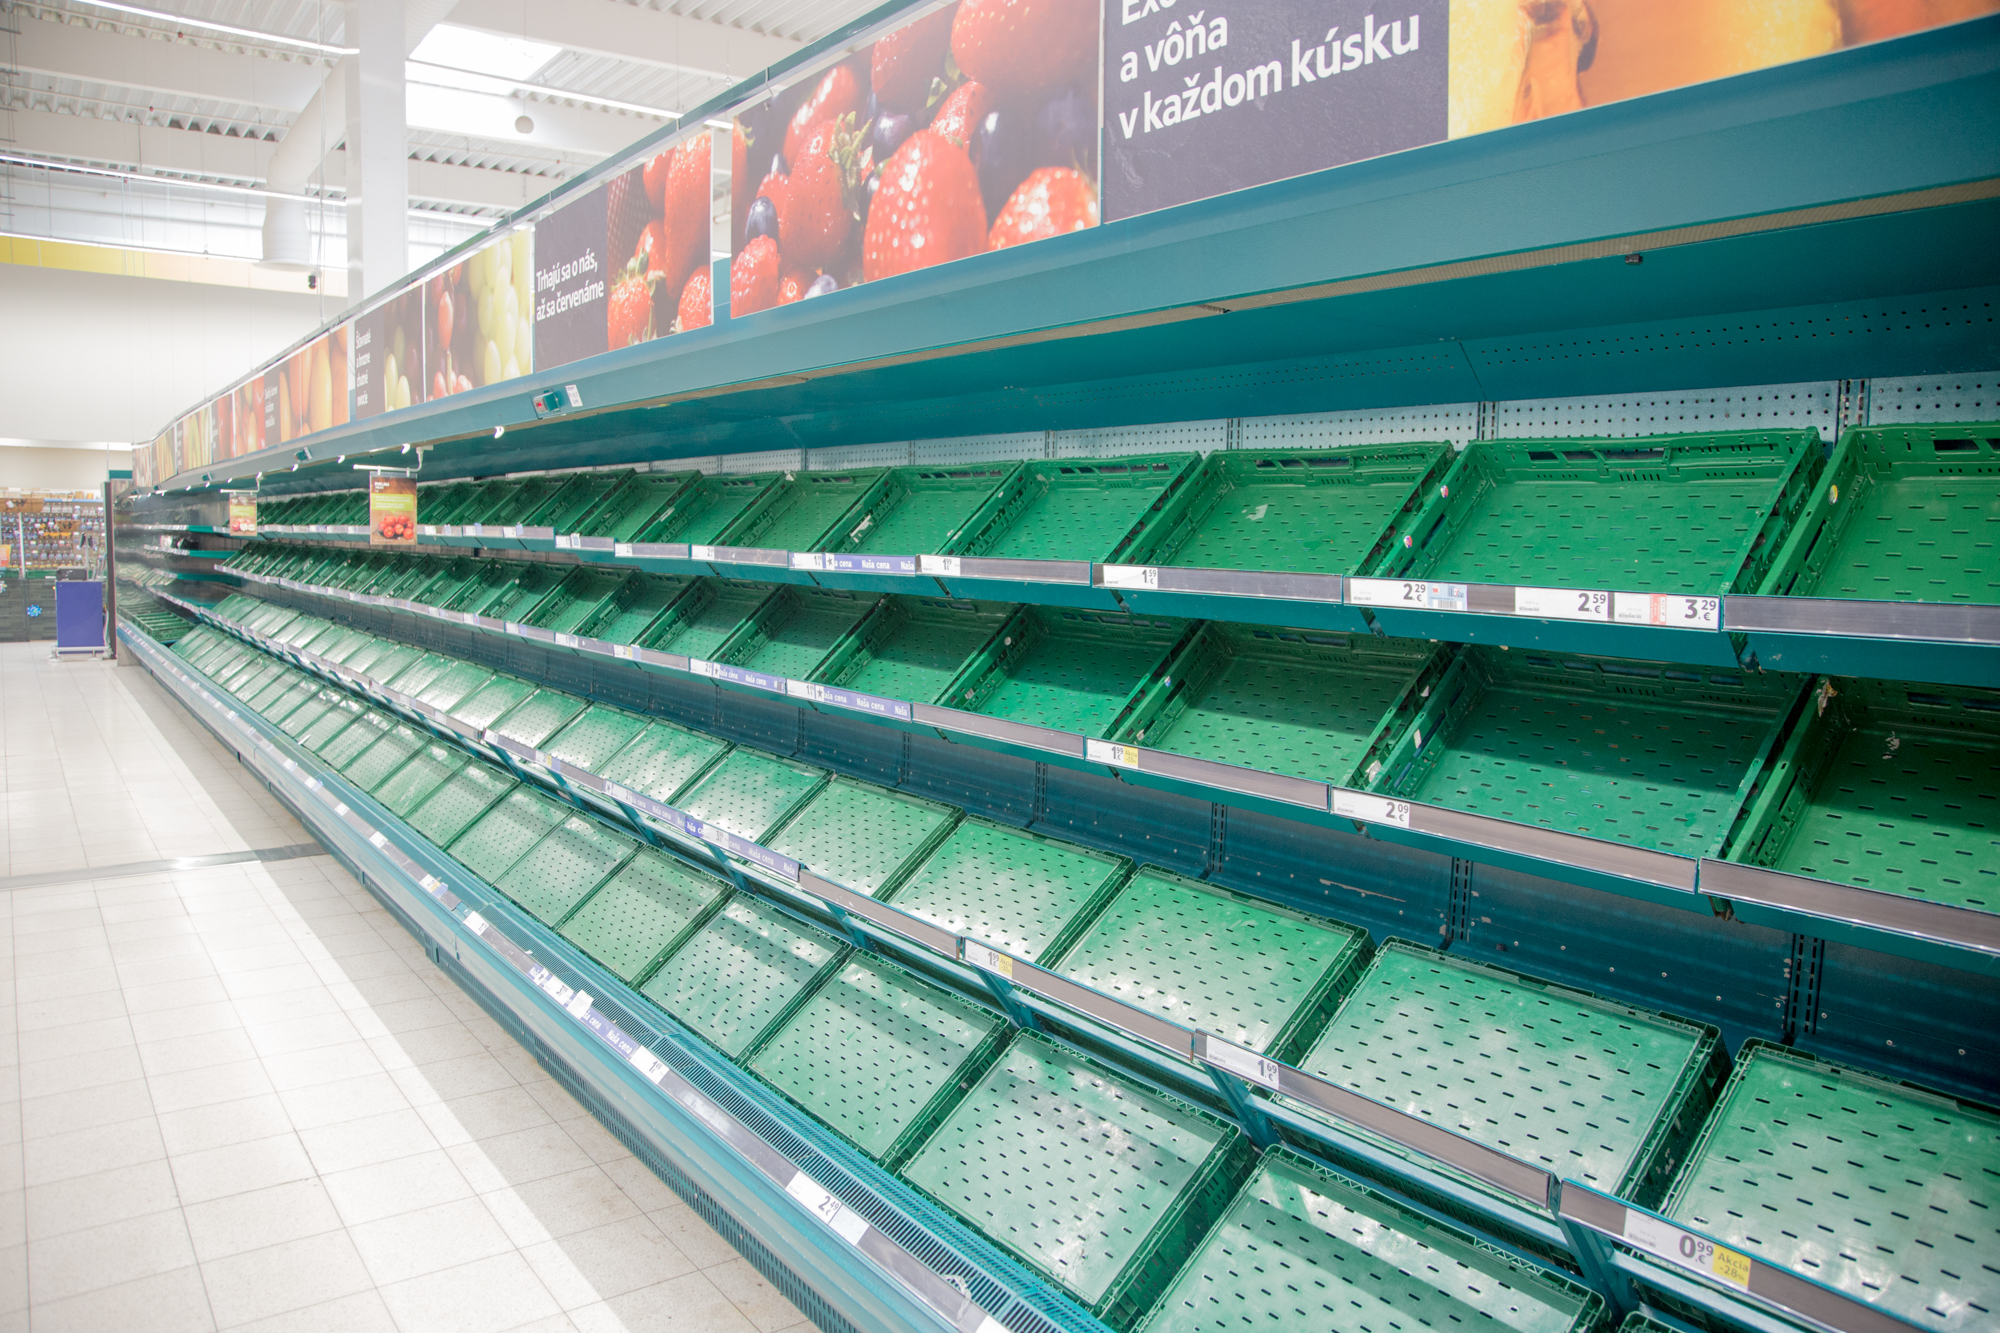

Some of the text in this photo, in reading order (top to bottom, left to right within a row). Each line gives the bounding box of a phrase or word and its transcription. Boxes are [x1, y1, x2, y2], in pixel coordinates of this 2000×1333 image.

[1120, 10, 1228, 82] a vôňa
[1118, 14, 1419, 139] v každom kúsku
[536, 247, 598, 292] Trhajú sa o nás,
[536, 279, 604, 321] až sa červenáme
[861, 559, 875, 569] Naša
[900, 560, 915, 571] Naša
[856, 697, 869, 708] Naša
[895, 705, 907, 716] Naša
[783, 861, 795, 875] Naša
[606, 1029, 620, 1044] Naša
[1718, 1252, 1749, 1272] Akcia
